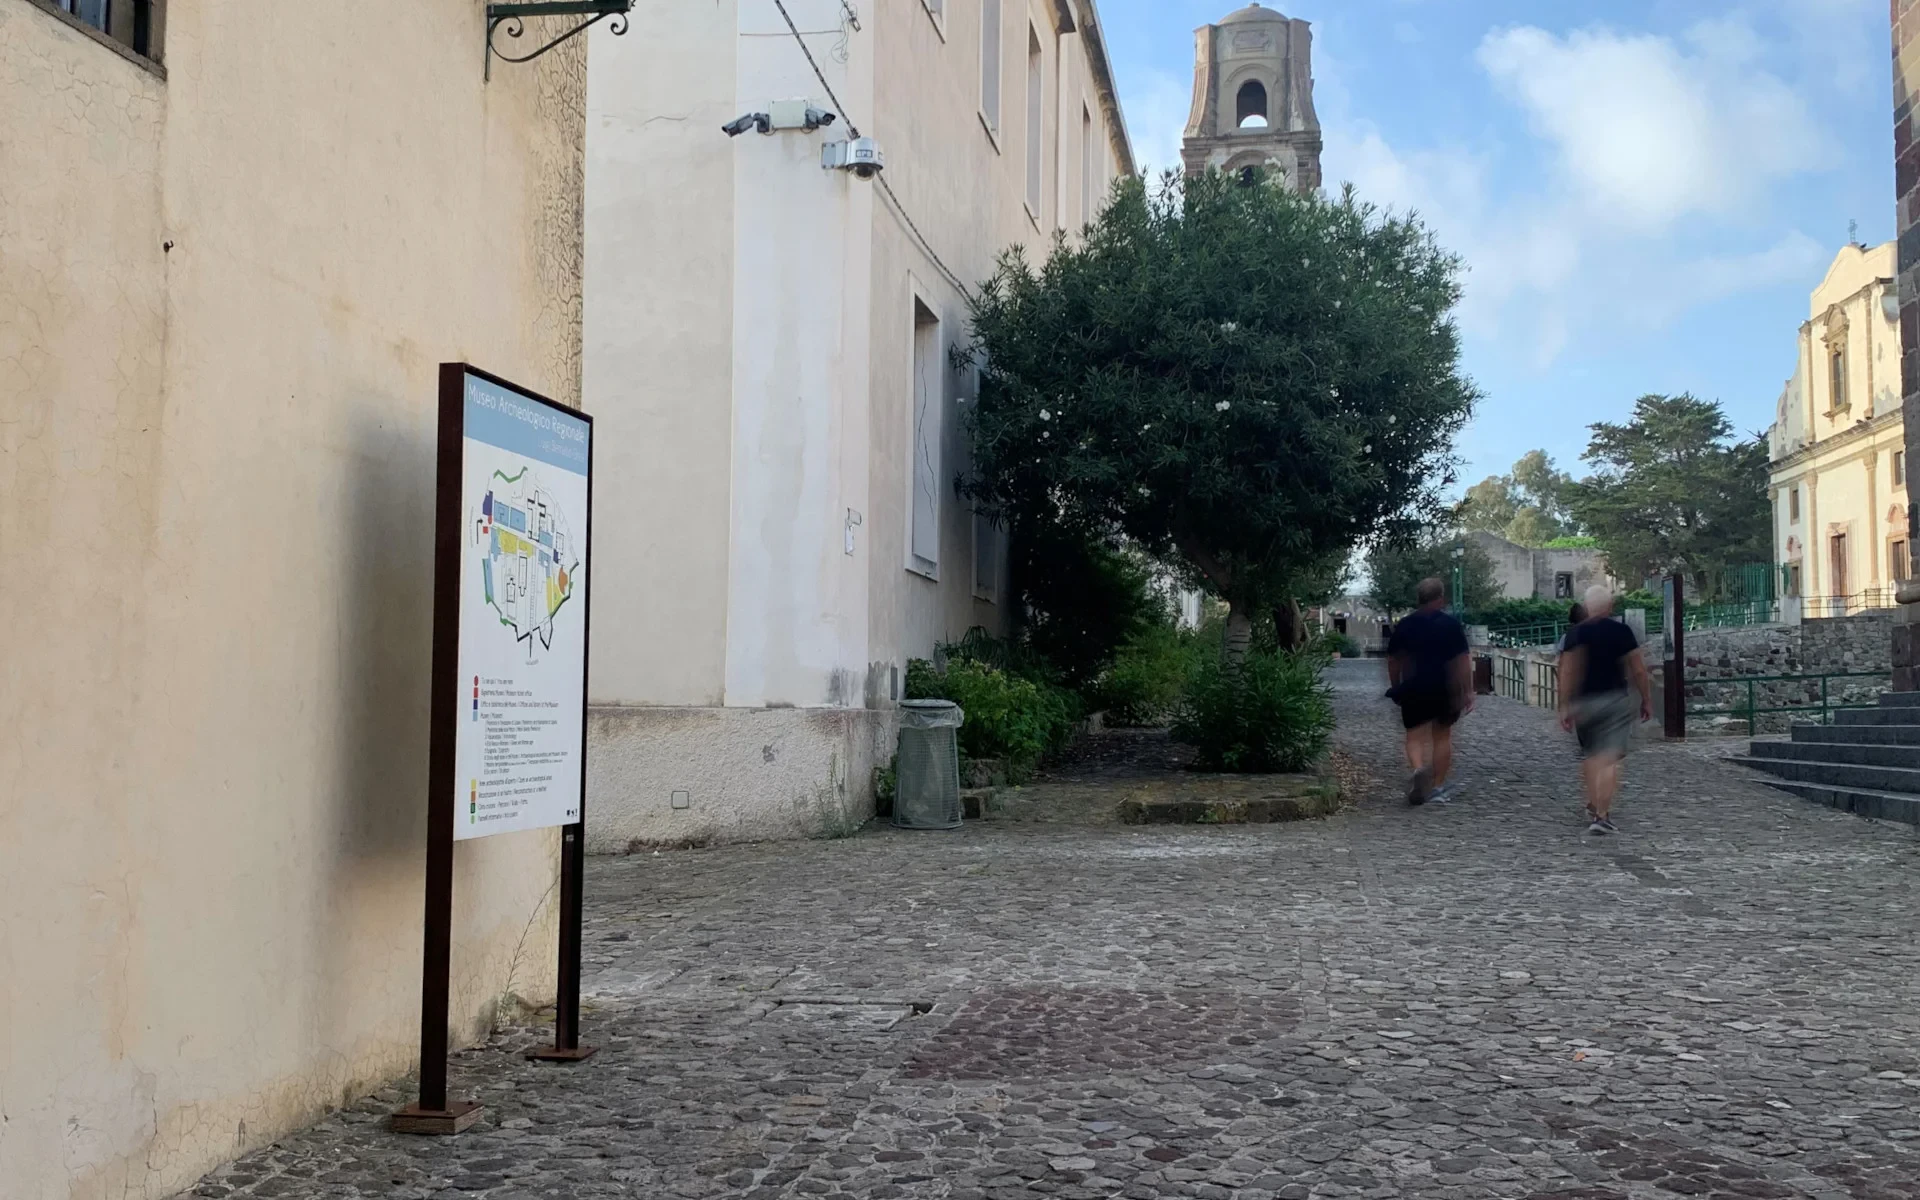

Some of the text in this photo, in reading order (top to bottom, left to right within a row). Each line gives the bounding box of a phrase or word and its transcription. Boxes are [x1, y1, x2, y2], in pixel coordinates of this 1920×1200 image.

[468, 384, 585, 443] Museo Archeologico Regionale
